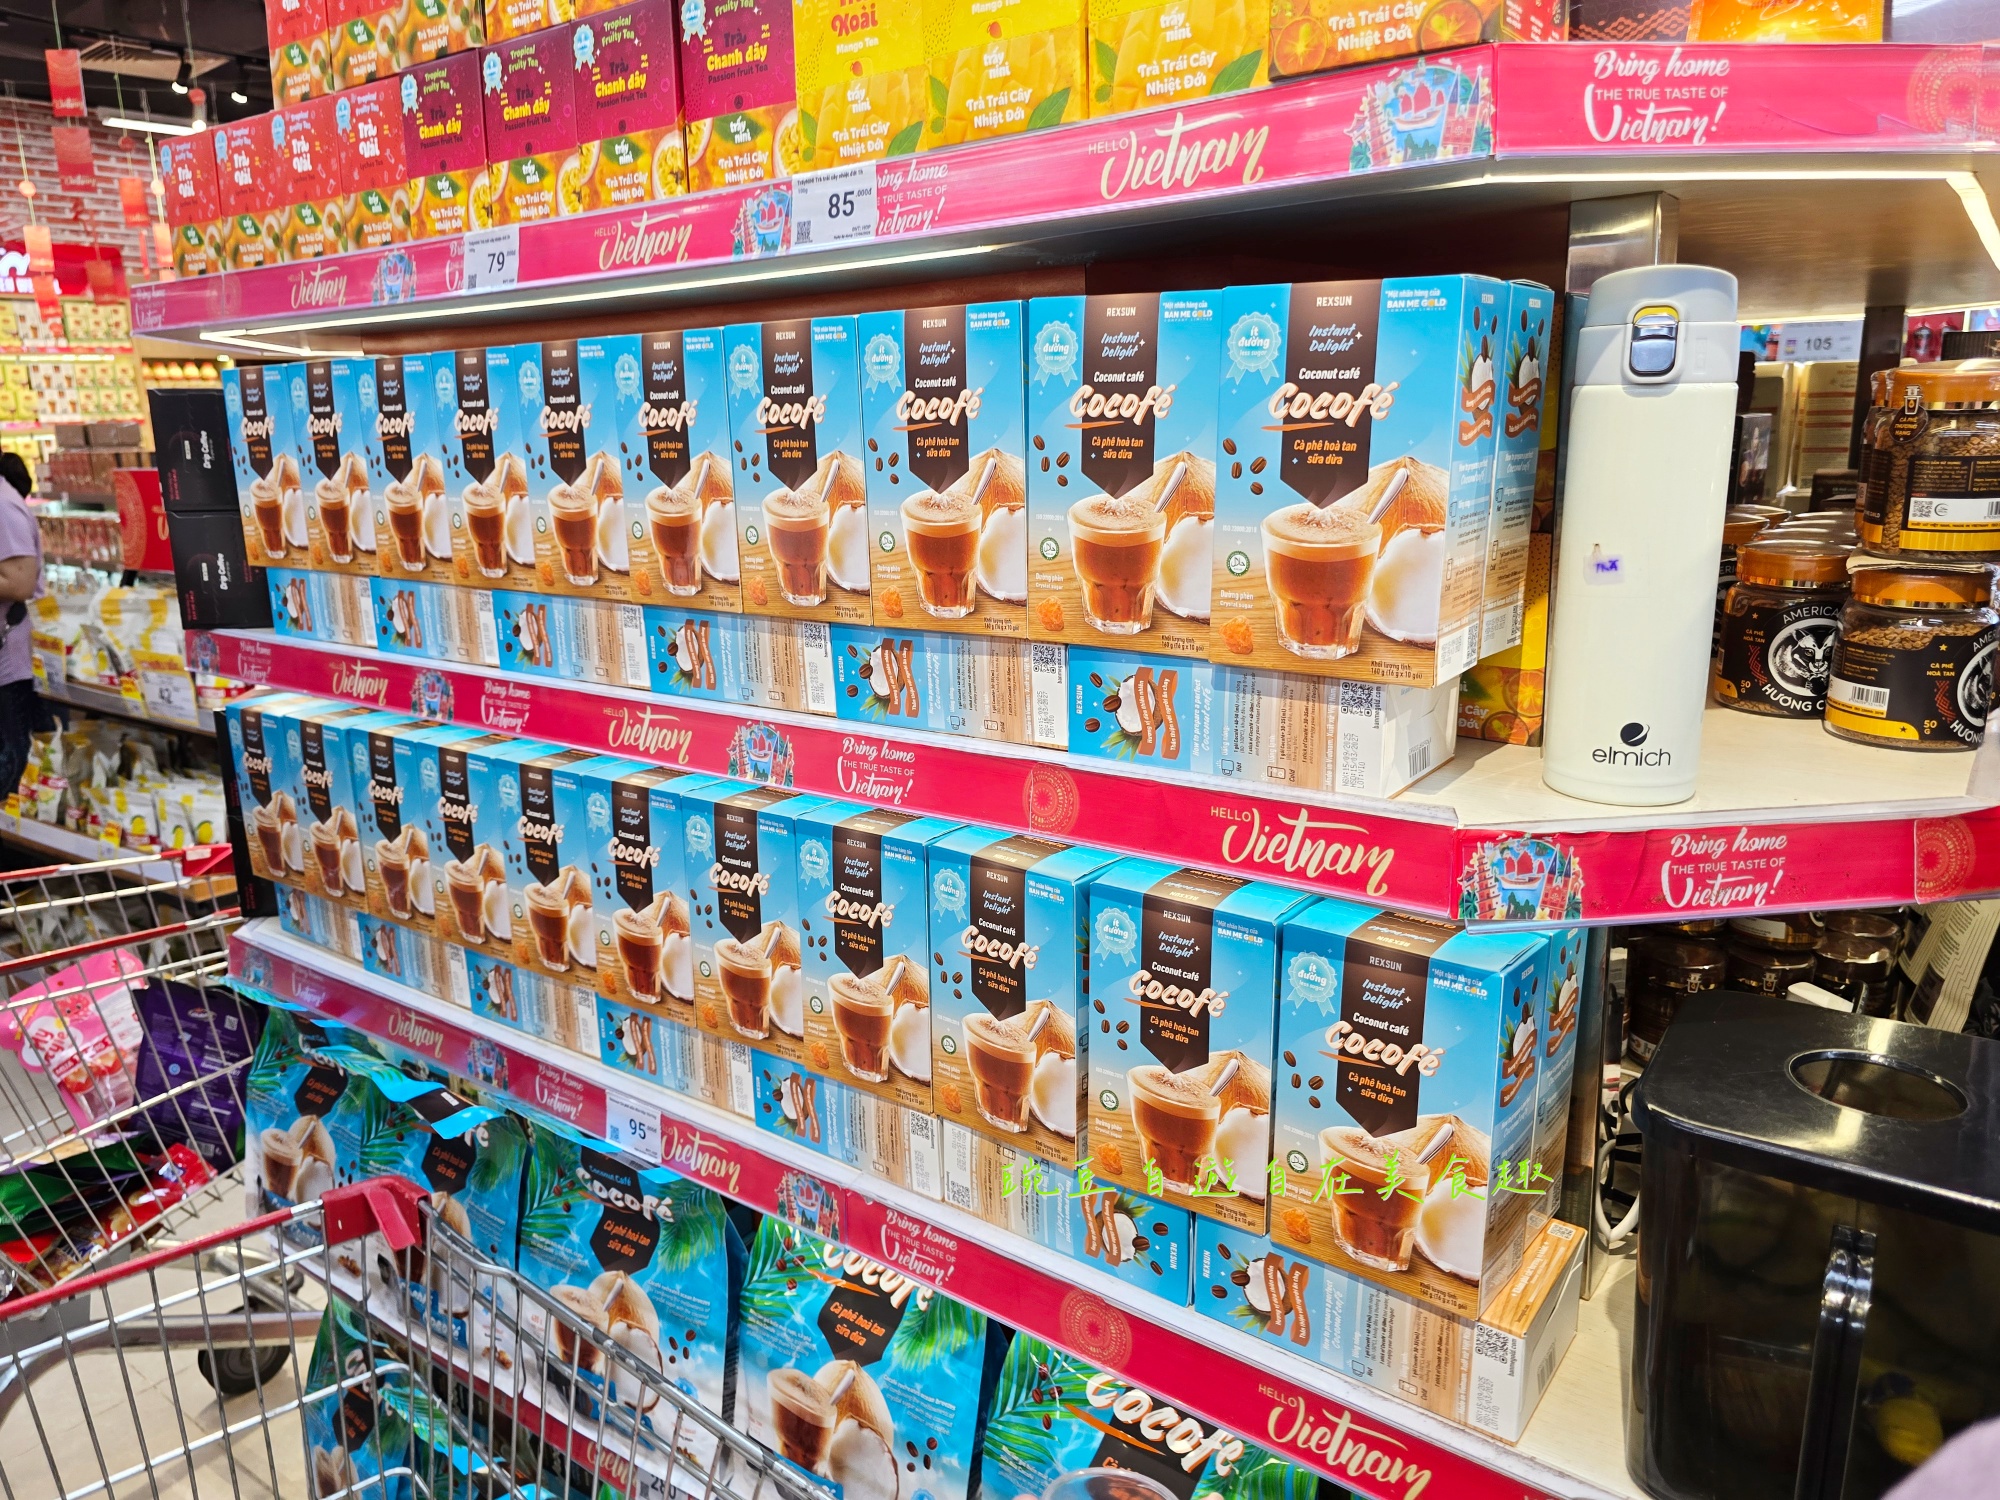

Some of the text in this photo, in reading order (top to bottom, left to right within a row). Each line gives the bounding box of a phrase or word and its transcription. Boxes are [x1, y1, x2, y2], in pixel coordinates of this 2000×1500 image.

[604, 15, 632, 31] Tropical
[831, 5, 878, 37] Xoài
[1329, 2, 1427, 32] Trà Trái Cây
[602, 30, 621, 47] Fruity
[724, 29, 746, 48] Trà
[1337, 23, 1414, 51] Nhiệt Đới
[707, 43, 768, 71] Chanh dây
[1138, 50, 1218, 78] Trà Trái Cây
[1594, 46, 1730, 85] Bring home
[708, 64, 768, 84] Passion fruit Tea
[1146, 71, 1206, 96] Nhiệt Đới
[966, 88, 1032, 112] Trà Trái Cây
[1595, 86, 1728, 100] THE TRUE TASTE OF
[1584, 83, 1726, 146] Vietnam!
[1088, 138, 1129, 156] HELLO
[1101, 112, 1270, 199] Vietnam
[877, 169, 904, 191] ring
[907, 159, 948, 184] home
[828, 191, 855, 219] 85
[883, 185, 947, 205] TRUE TASTE OF
[595, 225, 616, 237] HELLO
[599, 211, 692, 270] Vietnam
[487, 251, 505, 273] 79
[1107, 307, 1136, 317] REXSUN
[1316, 296, 1352, 307] REXSUN
[1387, 300, 1405, 308] BAN
[1406, 299, 1419, 308] ME
[1309, 324, 1356, 337] Instant
[1804, 337, 1832, 350] 105
[1310, 338, 1354, 355] Delight
[1094, 371, 1144, 382] Coconut café
[1299, 367, 1360, 380] Coconut café
[638, 400, 698, 432] Cocofé
[756, 395, 827, 431] Cocofé
[896, 387, 985, 426] Cocofé
[1069, 384, 1177, 425] Cocofé
[1268, 381, 1400, 427] Cocofé
[455, 408, 499, 436] Cocofé
[540, 403, 592, 434] Cocofé
[201, 430, 211, 469] Drip Coffee
[1294, 440, 1356, 453] Cà phê hoà tan
[1307, 454, 1343, 465] sữa dừa
[218, 553, 228, 590] Drip Coffee
[1741, 680, 1751, 688] 50
[1762, 683, 1812, 711] HƯƠNG
[603, 707, 624, 718] HELLO
[1924, 720, 1937, 728] 50
[608, 706, 693, 764] Vietnam
[842, 737, 915, 762] Bring home
[1592, 746, 1671, 767] elmich
[837, 756, 913, 805] Vietnam!
[843, 760, 857, 768] THE
[859, 762, 878, 771] TRUE
[880, 765, 902, 775] TASTE
[438, 797, 478, 823] Cocofé
[1211, 806, 1251, 822] HELLO
[517, 816, 564, 845] Cocofé
[1671, 827, 1787, 860] Bring home
[608, 837, 660, 868] Cocofé
[1222, 808, 1395, 896] Vietnam
[1672, 857, 1786, 874] THE TRUE TASTE OF
[709, 862, 773, 896] Cocofé
[1661, 860, 1783, 908] Vietnam!
[825, 890, 895, 929] Cocofé
[1163, 910, 1191, 923] REXSUN
[960, 925, 1041, 971] Cocofé
[1369, 956, 1402, 971] REXSUN
[1128, 969, 1230, 1018] Cocofé
[1362, 979, 1405, 997] Instant
[1433, 978, 1450, 986] BAN
[1363, 992, 1403, 1009] Delight
[1353, 1013, 1409, 1036] Coconut café
[1325, 1020, 1446, 1077] Cocofé
[1348, 1071, 1407, 1097] Cà phê hoà tan
[629, 1119, 646, 1140] 95
[661, 1127, 740, 1194] Vietnam
[886, 1210, 957, 1251] Bring home
[881, 1224, 954, 1286] Vietnam!
[887, 1229, 956, 1263] THE TRUE TASTE OF
[1258, 1384, 1297, 1407] HELLO
[1267, 1397, 1432, 1500] Vietnam
